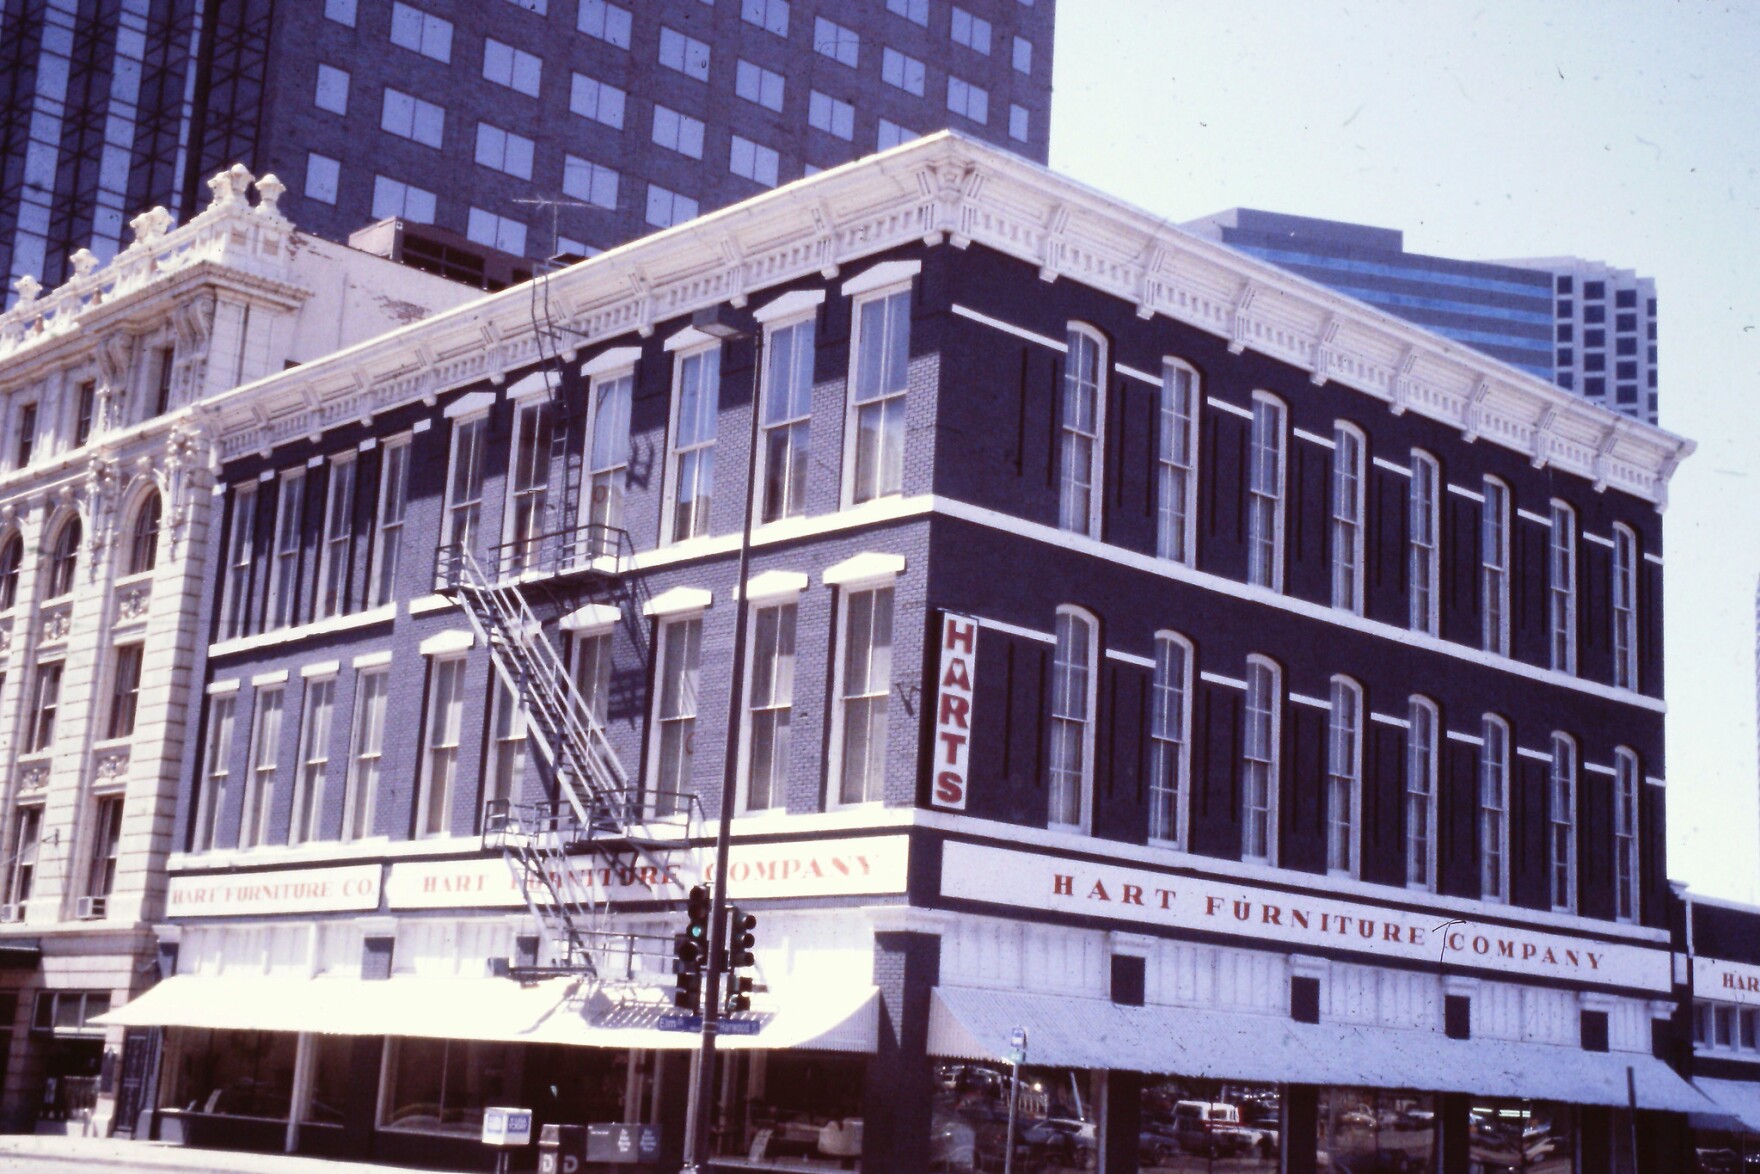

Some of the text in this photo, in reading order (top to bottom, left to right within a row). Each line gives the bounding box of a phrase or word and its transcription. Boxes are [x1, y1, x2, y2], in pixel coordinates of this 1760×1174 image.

[936, 619, 974, 803] HARTS
[172, 878, 375, 904] HART FURNITURE CO.
[423, 873, 489, 893] HART
[704, 853, 880, 882] COMPANY
[1053, 873, 1604, 970] HART FURNITURE COMPANY
